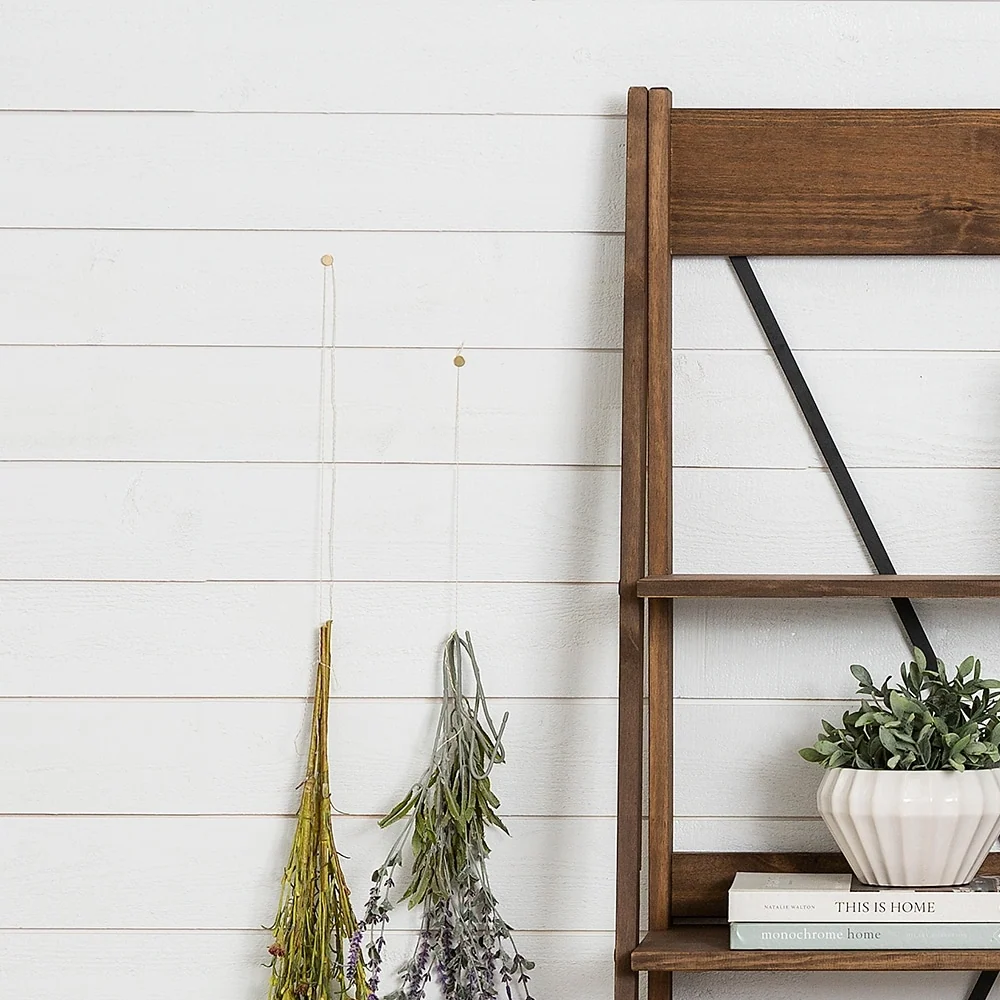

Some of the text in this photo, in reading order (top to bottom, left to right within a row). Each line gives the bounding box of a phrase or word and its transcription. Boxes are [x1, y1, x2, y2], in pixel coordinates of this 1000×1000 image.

[834, 901, 936, 913] THIS IS HOME
[761, 927, 881, 940] monochrome home
